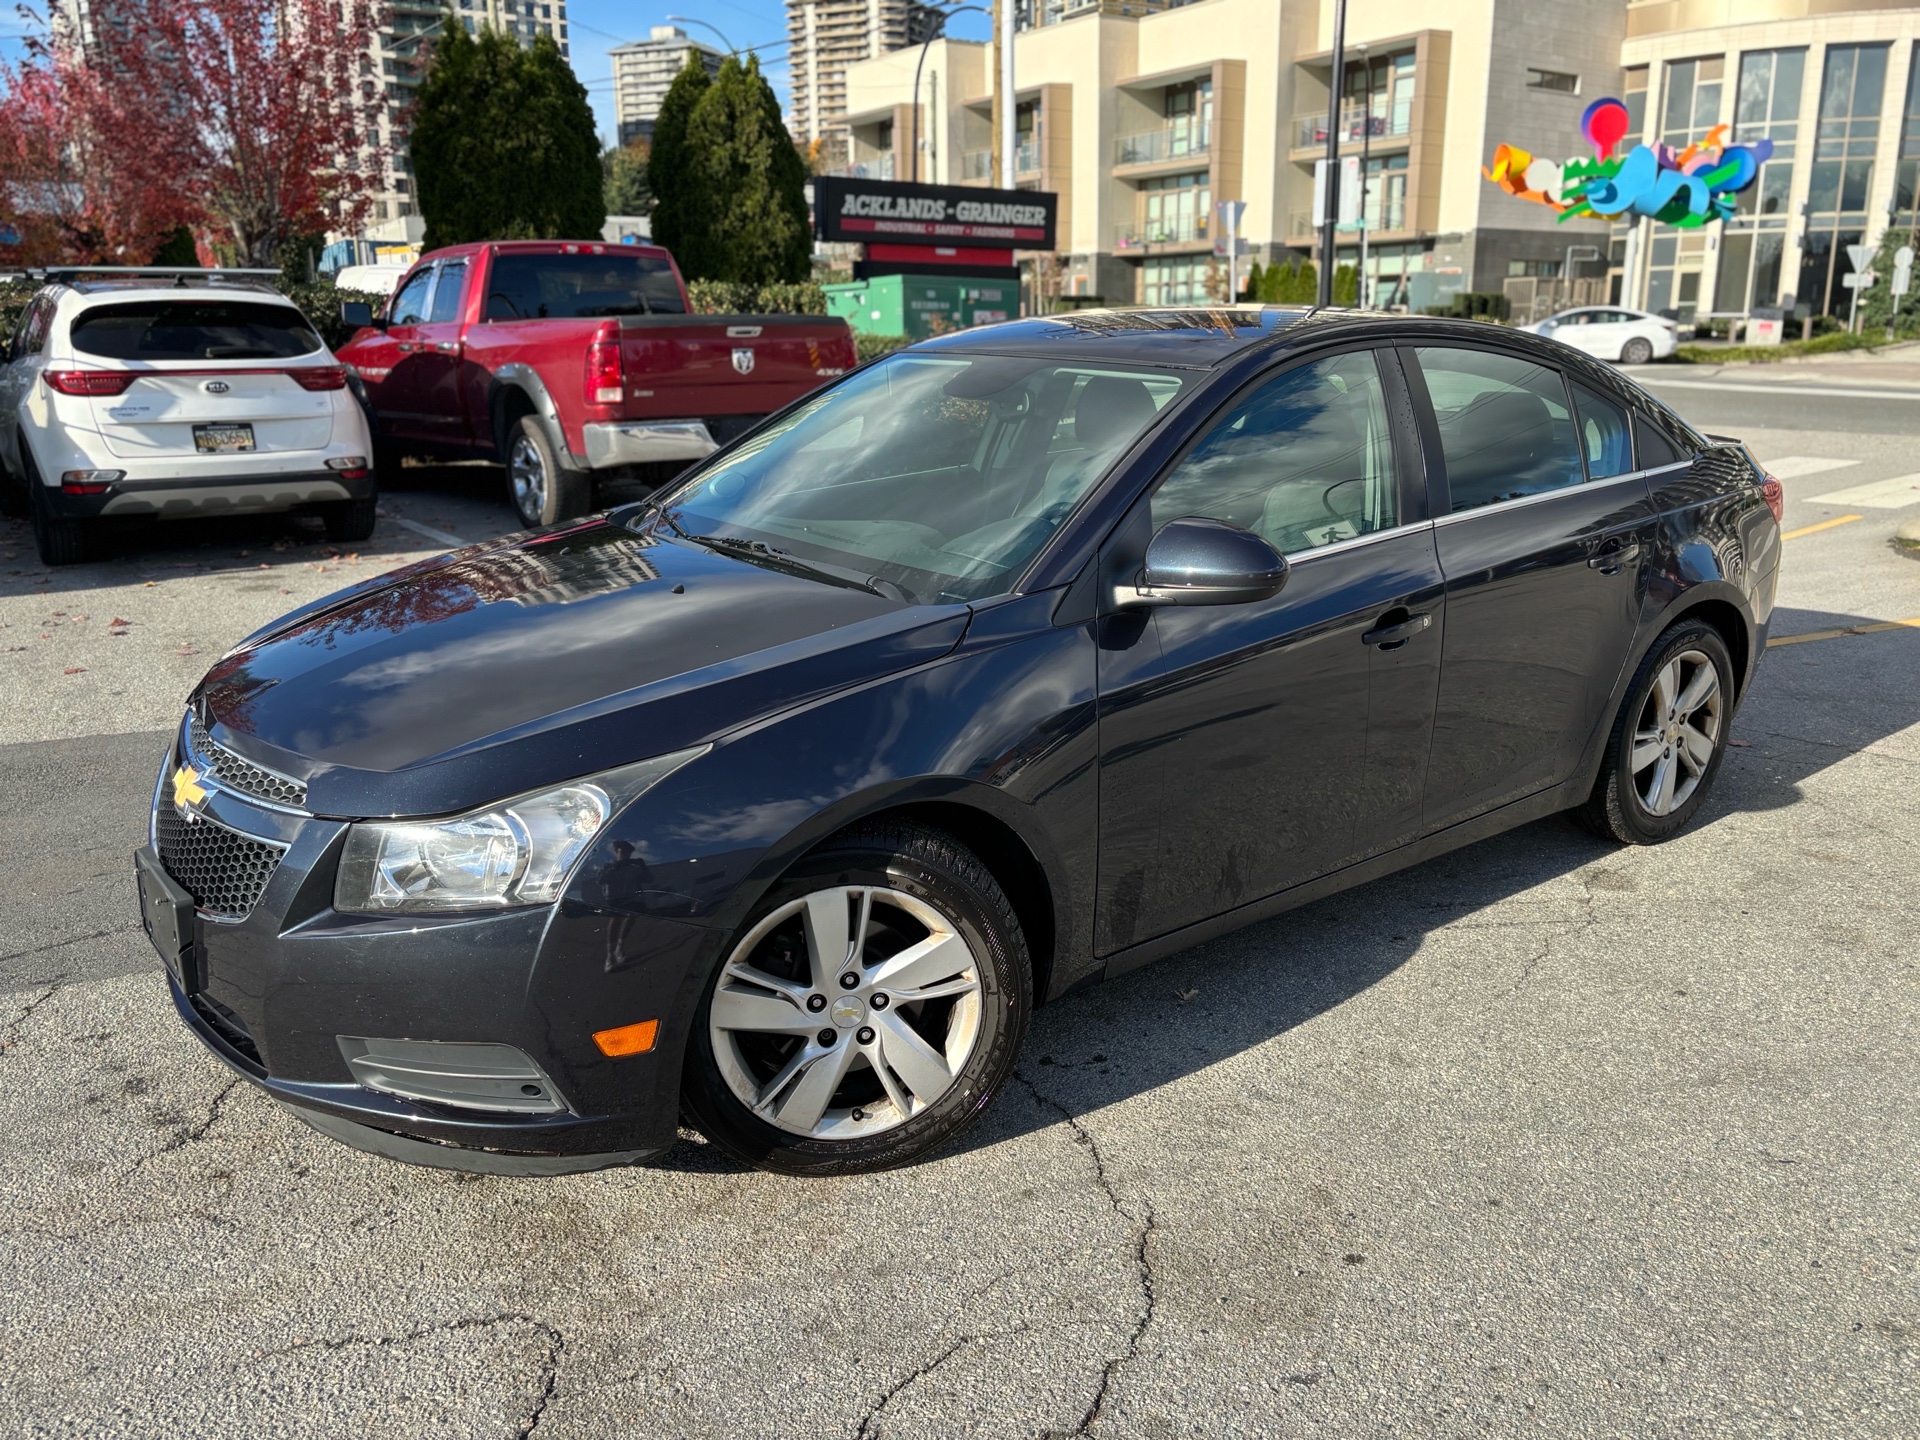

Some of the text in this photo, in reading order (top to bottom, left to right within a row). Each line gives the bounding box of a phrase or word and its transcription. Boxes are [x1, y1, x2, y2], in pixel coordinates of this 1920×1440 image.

[874, 221, 1015, 238] INDUSTRIAL SAFETY FASTENERS
[208, 383, 227, 393] KIA
